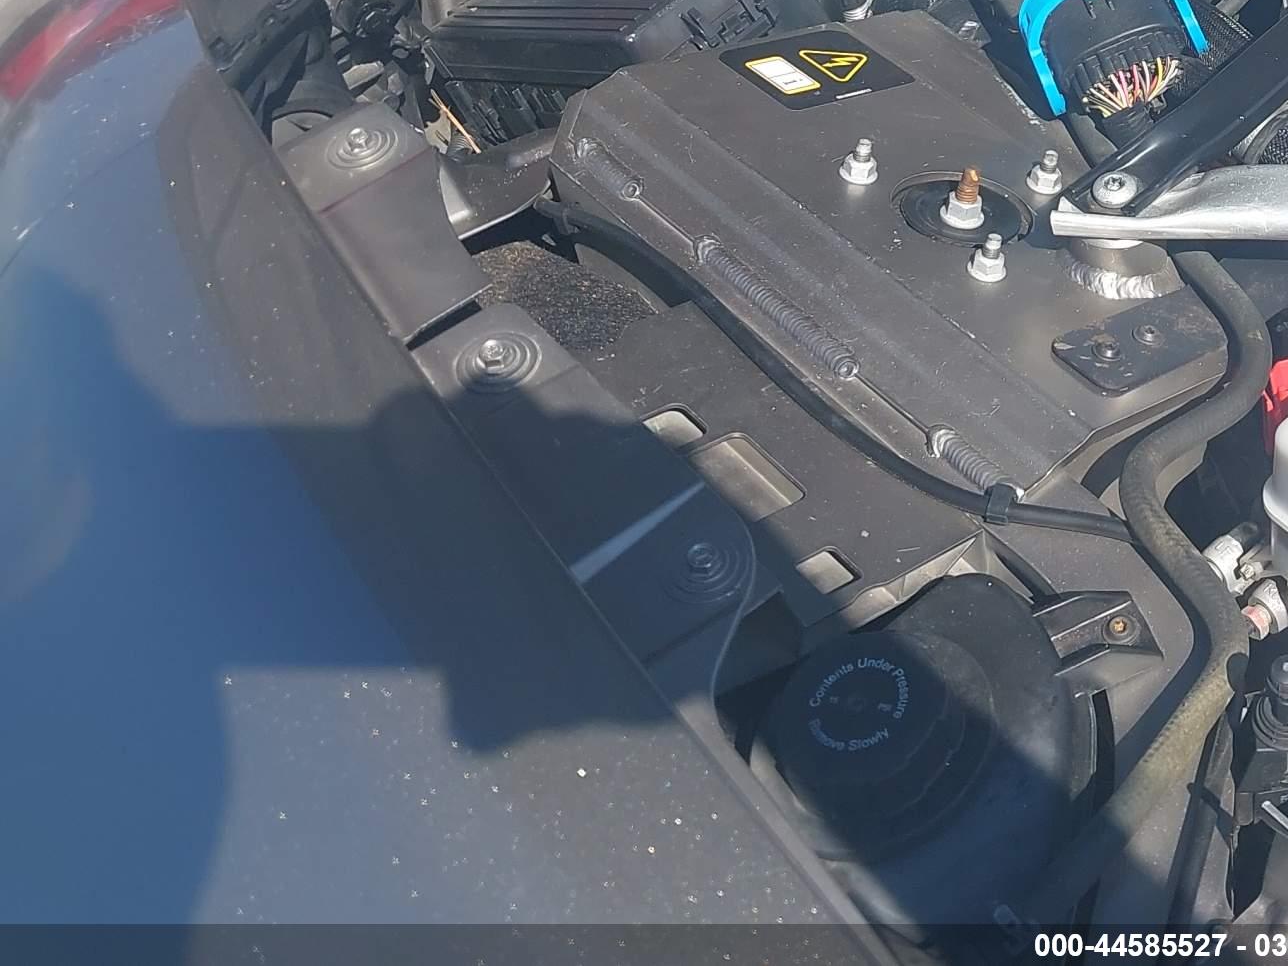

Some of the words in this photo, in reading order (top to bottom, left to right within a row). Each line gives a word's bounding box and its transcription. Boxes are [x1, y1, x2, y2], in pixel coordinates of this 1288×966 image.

[808, 663, 855, 707] Contents
[857, 657, 897, 674] Under
[891, 667, 910, 720] Pressure
[847, 727, 890, 752] Slowly
